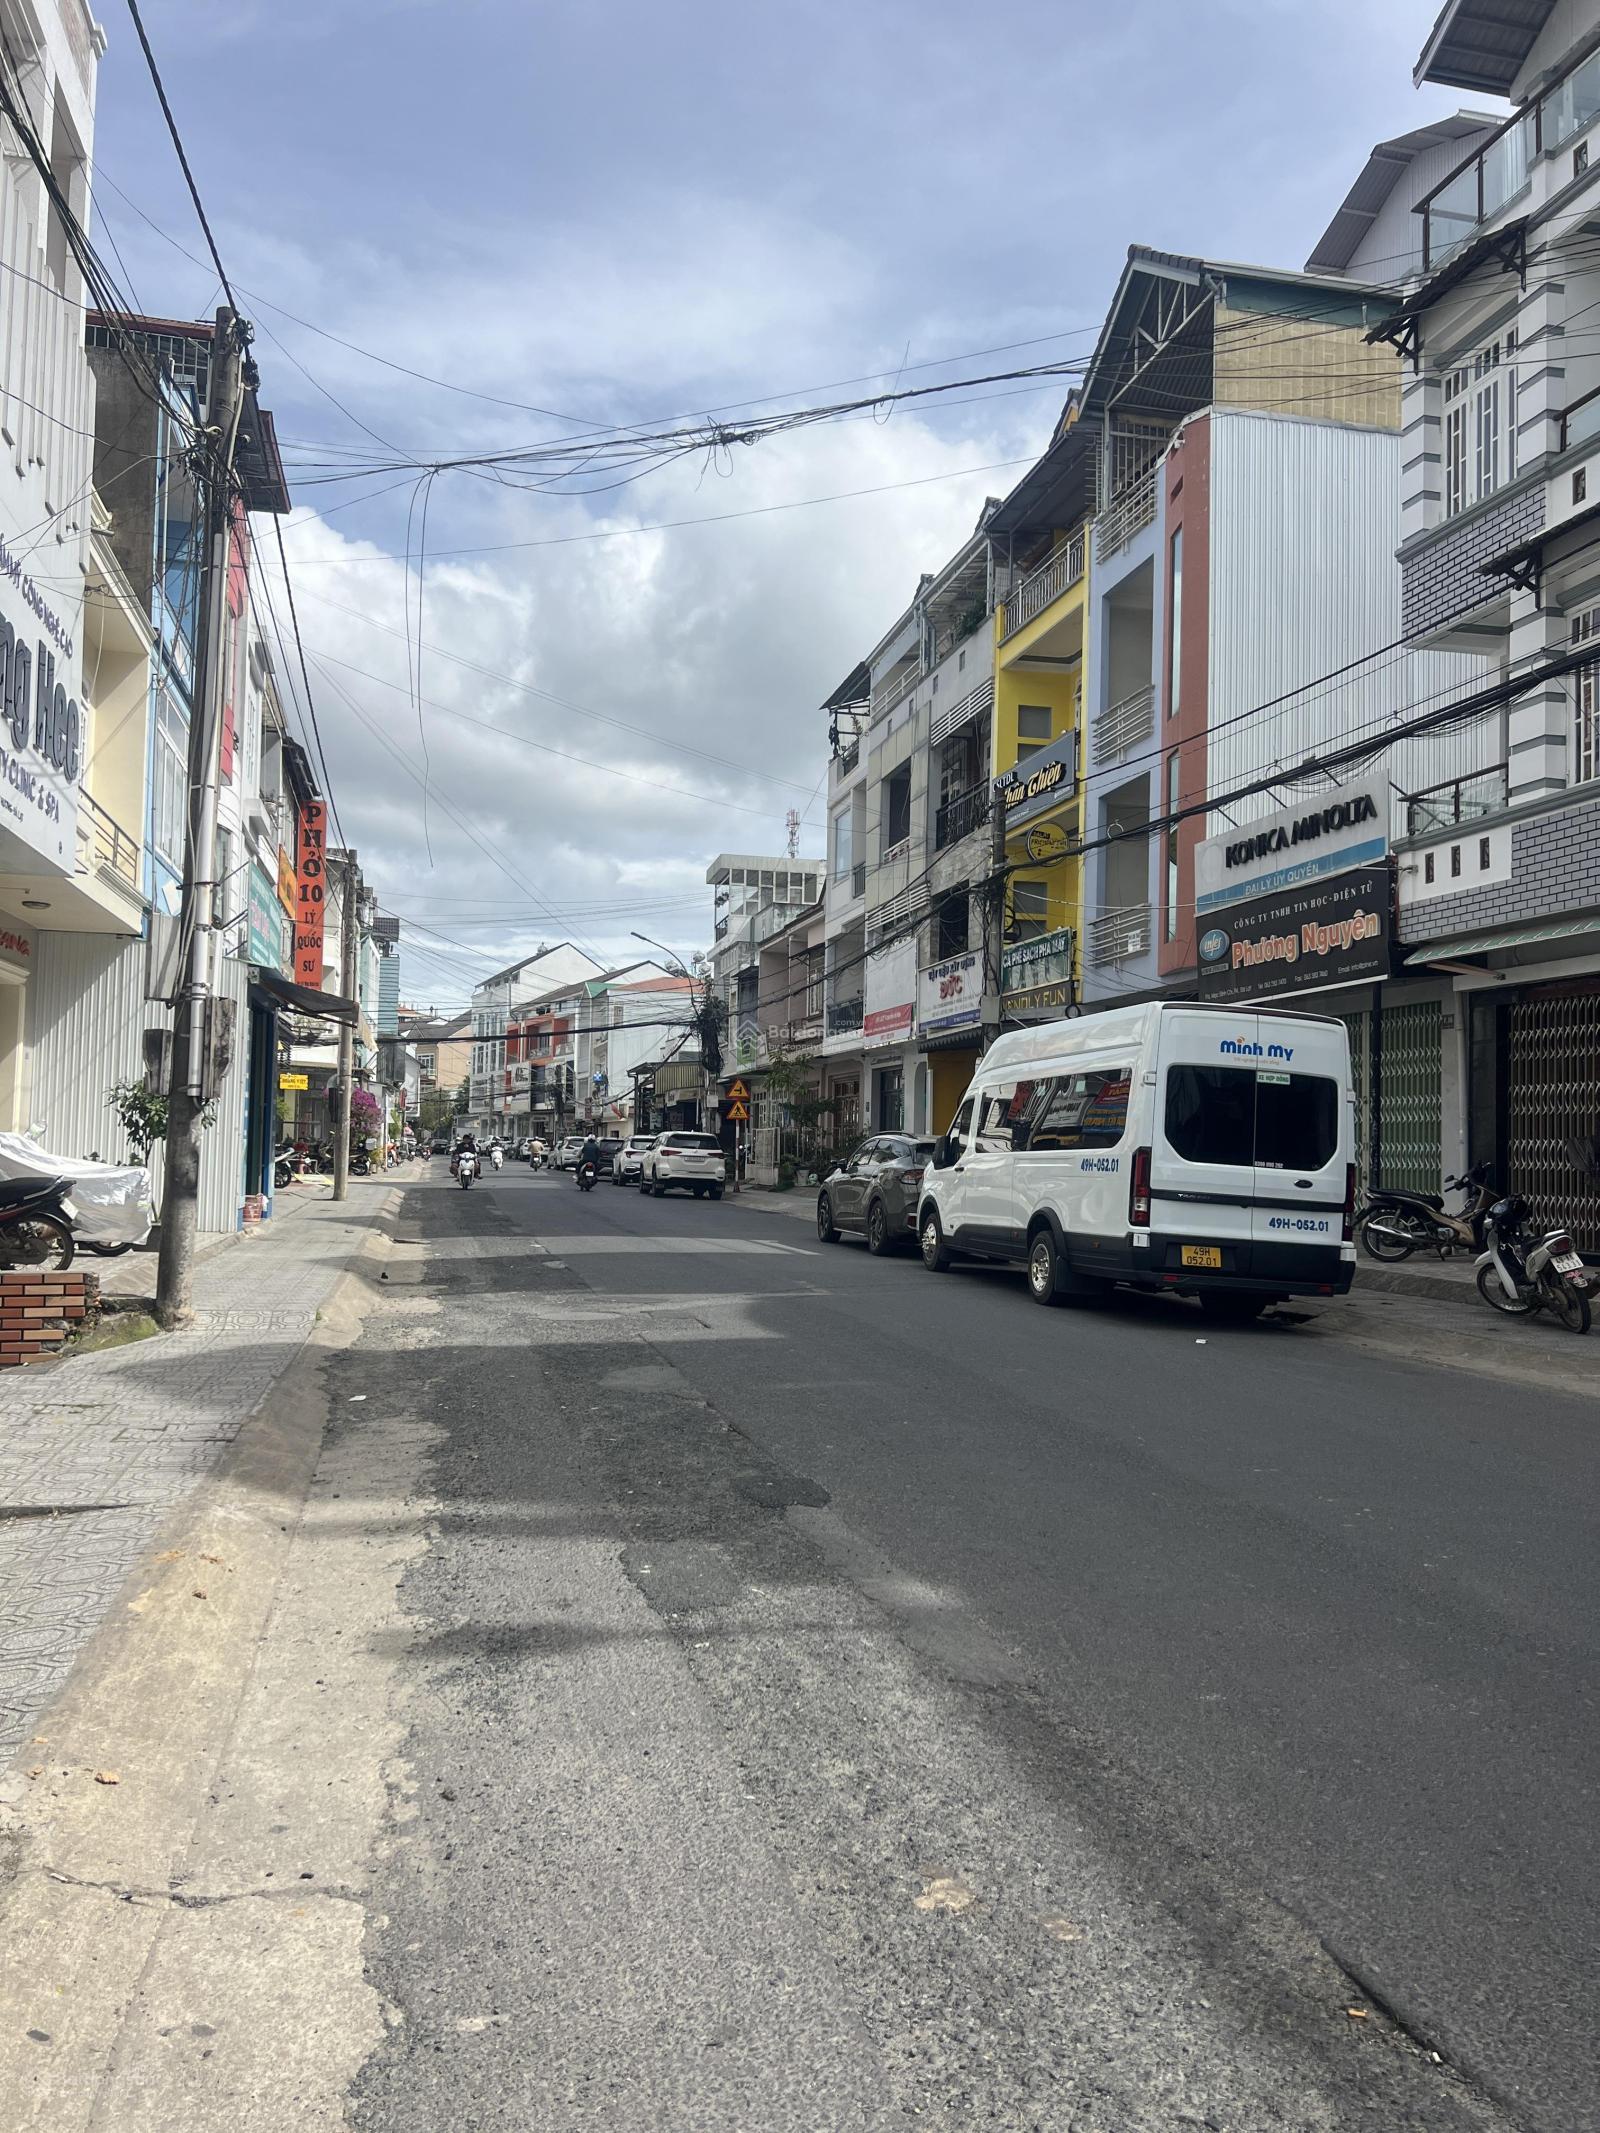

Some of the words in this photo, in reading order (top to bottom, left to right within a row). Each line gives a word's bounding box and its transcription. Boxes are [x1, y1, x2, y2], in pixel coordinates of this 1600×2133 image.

[1028, 761, 1062, 798] Thiện
[45, 791, 60, 824] SPA
[1225, 826, 1290, 869] KONICA
[1291, 793, 1378, 845] MINOLTA
[1260, 877, 1271, 891] LÝ
[1287, 863, 1319, 883] QUYỀN
[299, 884, 323, 903] 10
[1234, 913, 1256, 930] CÔNG
[1257, 912, 1268, 924] TY
[1270, 905, 1291, 920] TNHH
[1294, 900, 1308, 913] TIN
[1360, 879, 1373, 895] TỬ
[298, 931, 322, 949] QUỐC
[1232, 934, 1299, 970] Phương
[1302, 908, 1381, 956] Nguyên
[1043, 987, 1066, 1007] FUN
[1220, 1036, 1263, 1056] Minh
[1267, 1043, 1294, 1062] My
[1081, 1157, 1119, 1173] 49H-052.01
[1269, 1217, 1329, 1232] 49H-052.01
[1193, 1247, 1211, 1257] 49H
